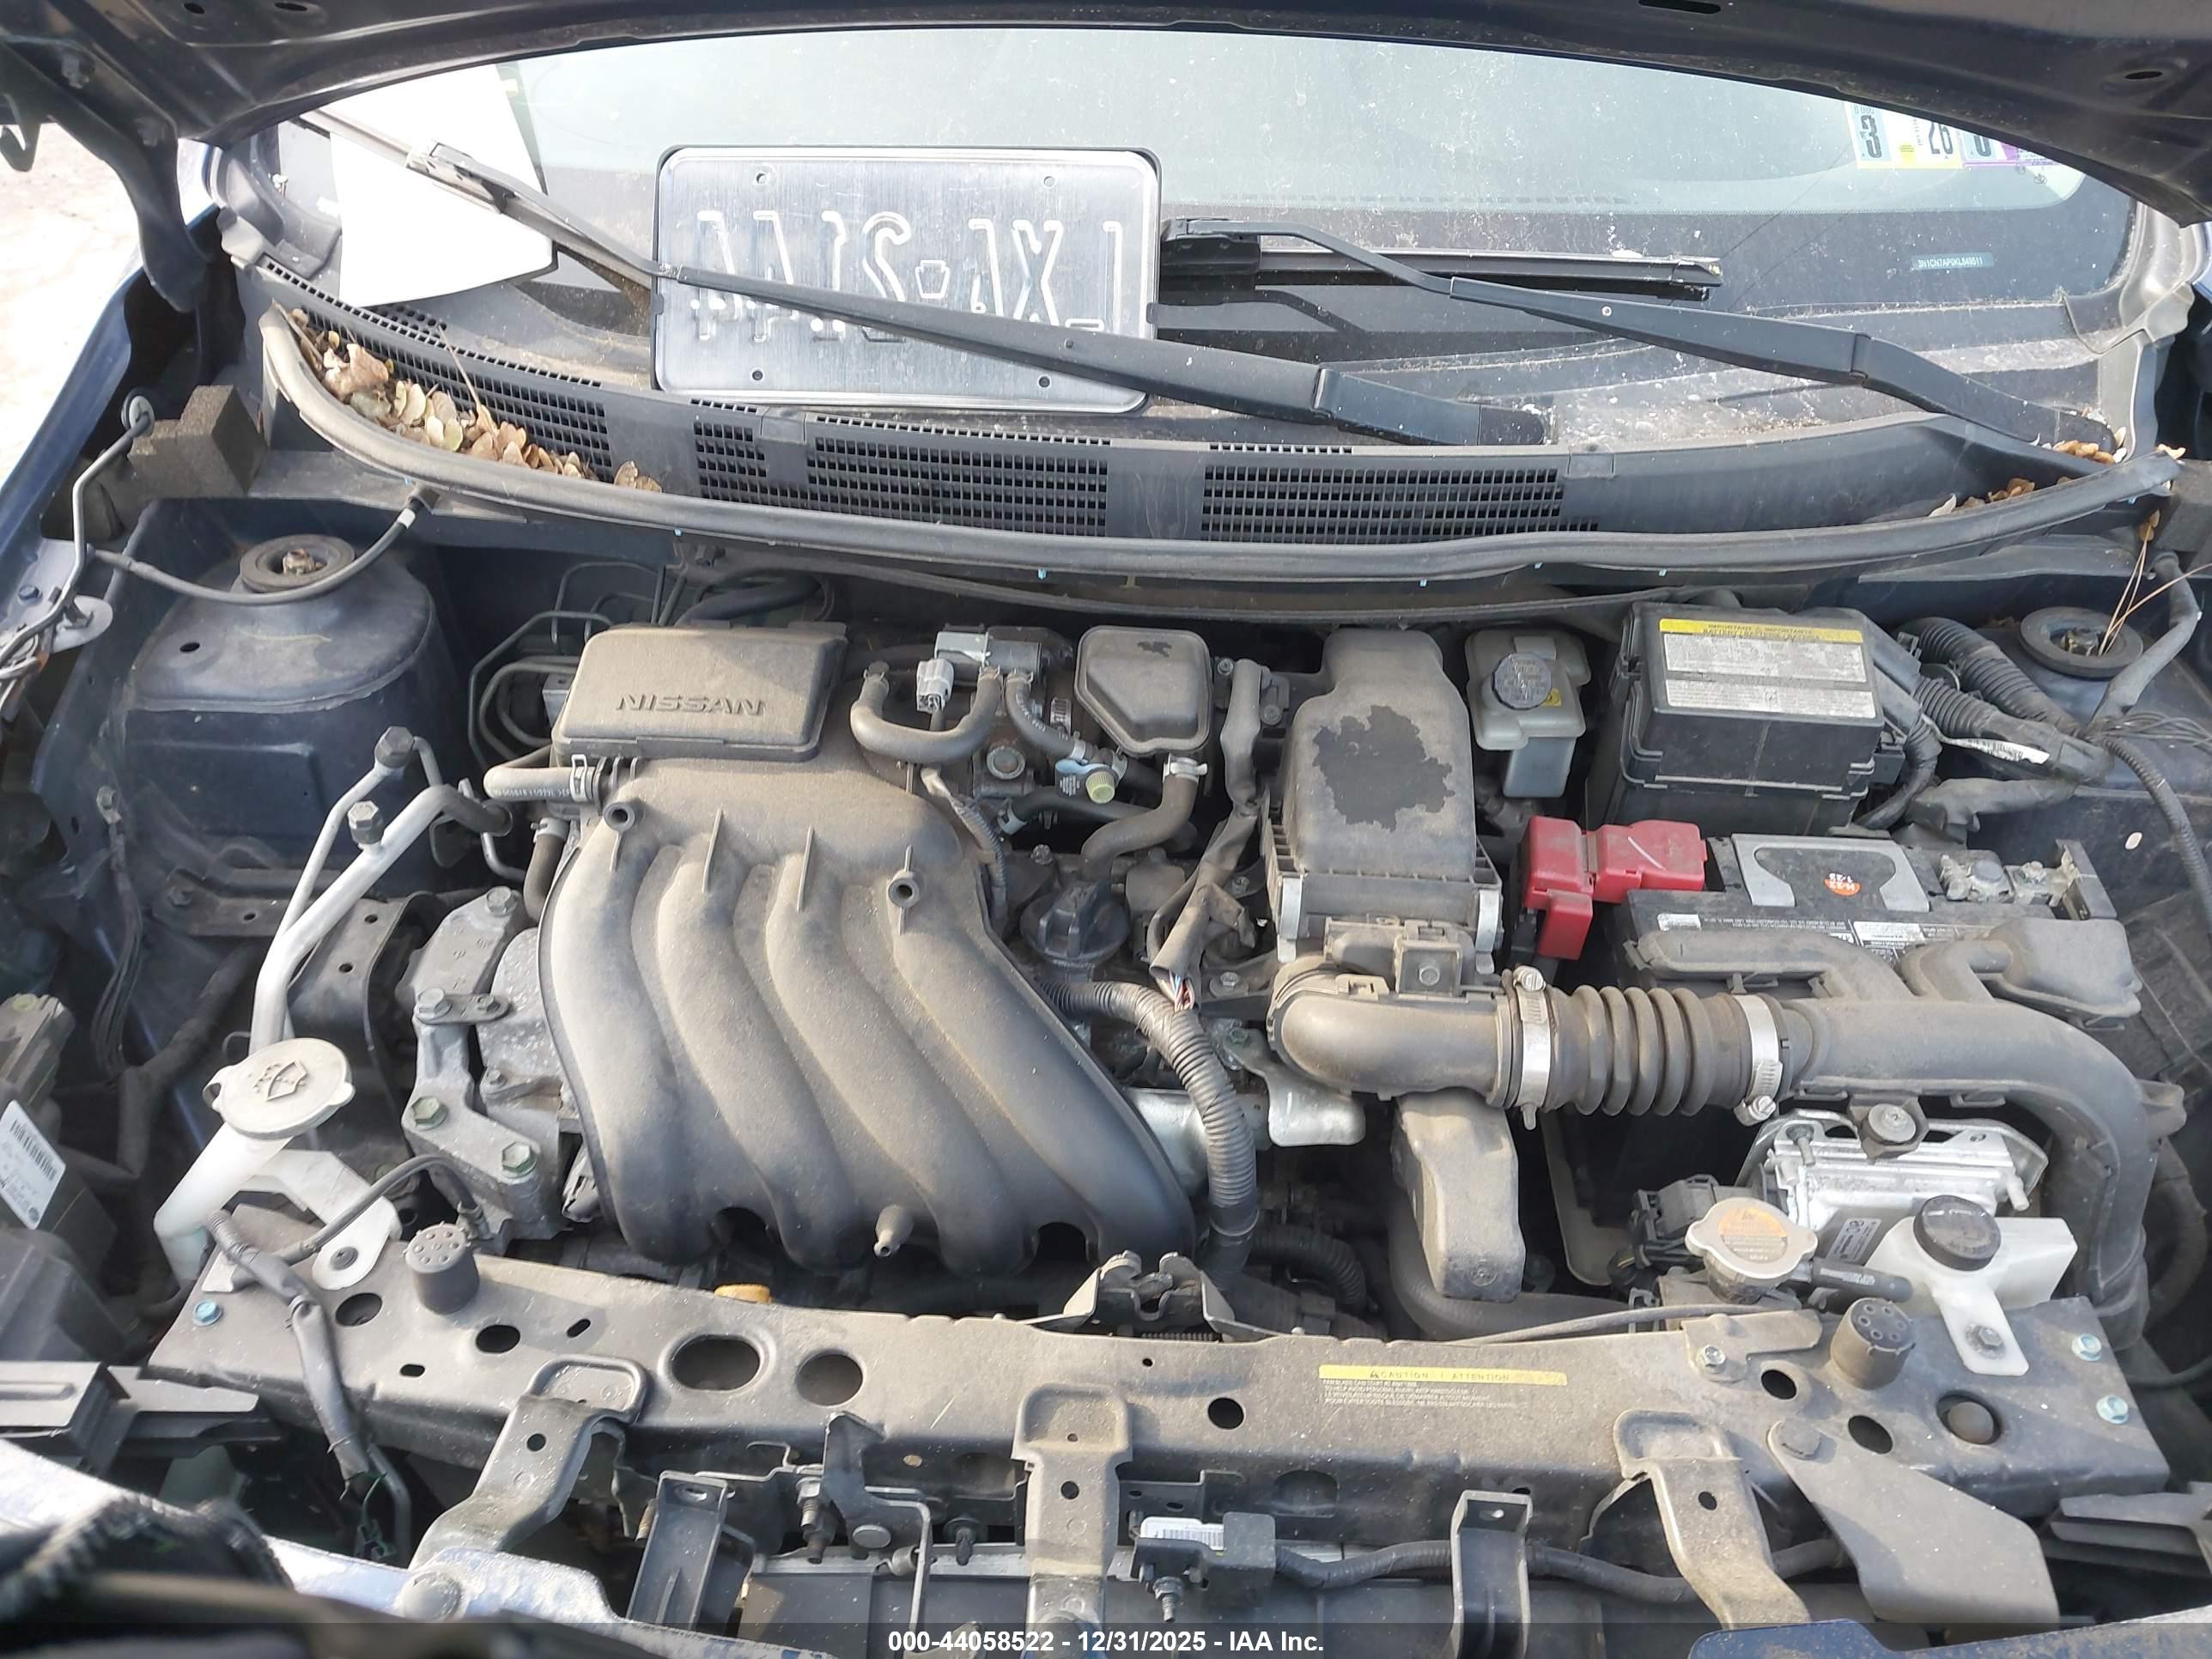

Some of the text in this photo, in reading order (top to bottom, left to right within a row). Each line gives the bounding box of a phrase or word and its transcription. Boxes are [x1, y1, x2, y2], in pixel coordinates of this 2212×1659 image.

[1861, 114, 1882, 158] 3
[617, 694, 763, 715] NISSAN
[1380, 1371, 1510, 1382] CAUTION ATTENTION
